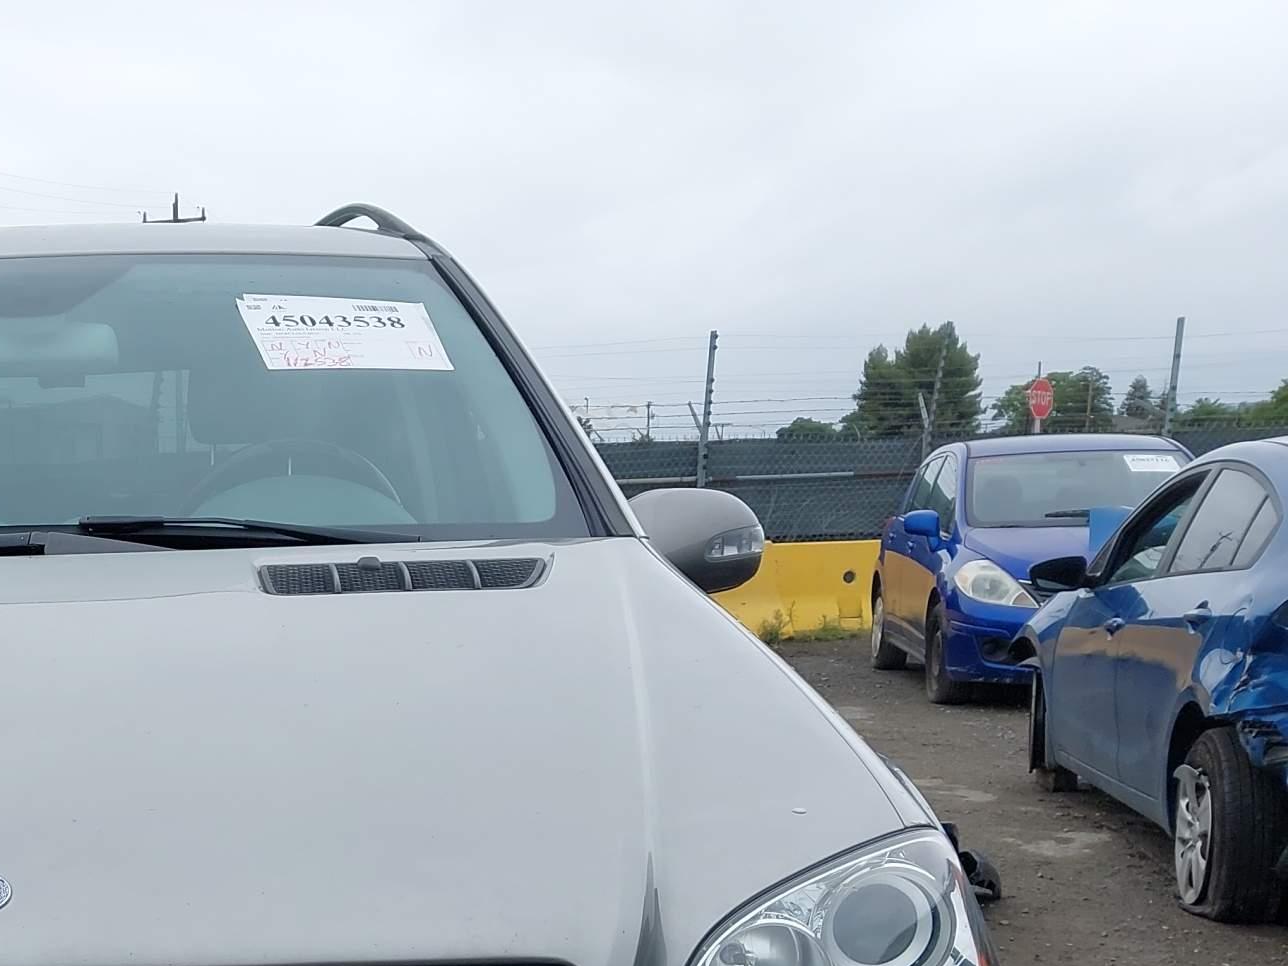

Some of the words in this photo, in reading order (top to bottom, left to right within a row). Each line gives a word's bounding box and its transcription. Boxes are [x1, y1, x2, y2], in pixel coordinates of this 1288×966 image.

[264, 313, 406, 330] 45043538
[418, 345, 433, 358] N
[1031, 390, 1052, 405] STOP
